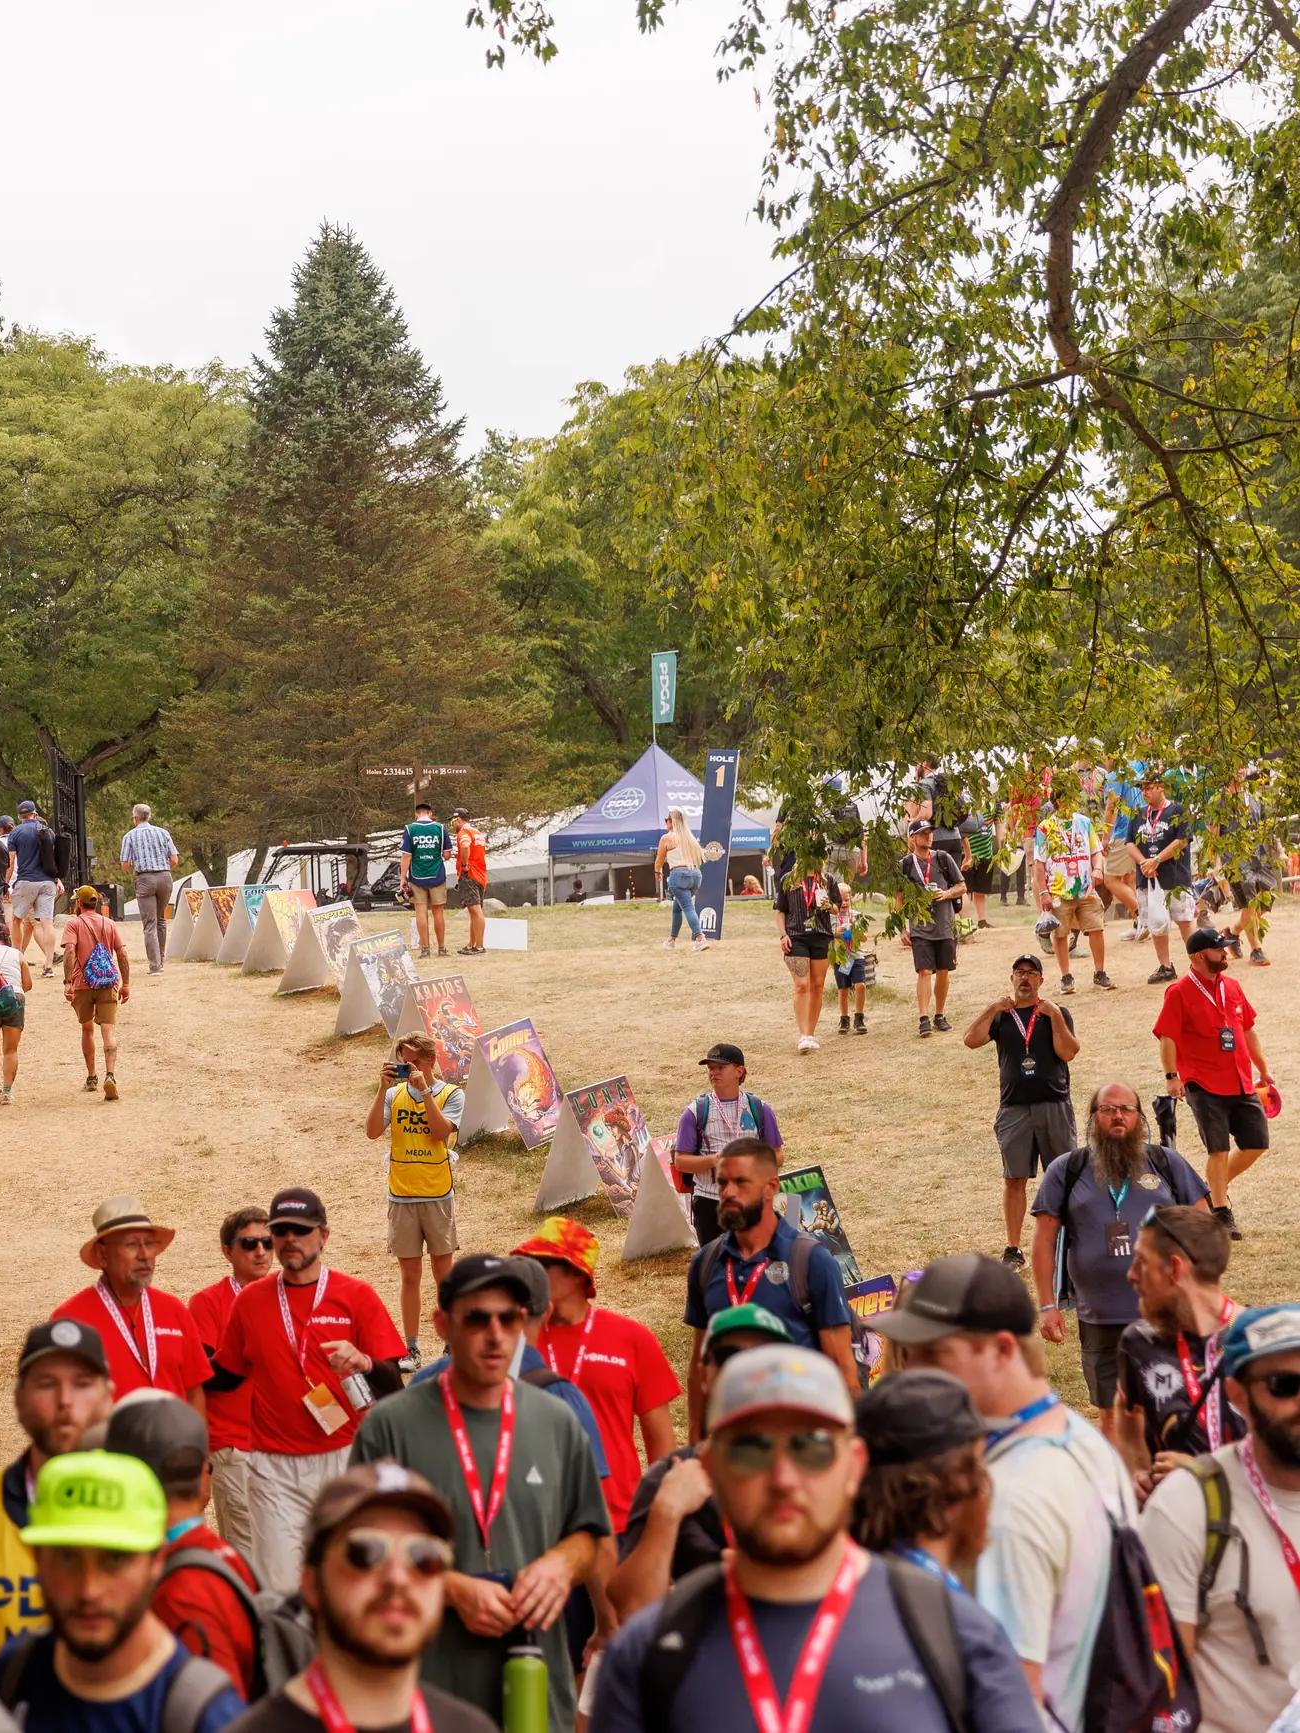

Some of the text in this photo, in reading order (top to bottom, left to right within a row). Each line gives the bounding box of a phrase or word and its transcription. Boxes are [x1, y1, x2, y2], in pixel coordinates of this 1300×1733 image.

[659, 662, 670, 716] PDGA
[709, 755, 734, 763] HOLE
[715, 765, 726, 787] 1
[607, 798, 640, 809] PDGA
[413, 835, 440, 845] PDGA
[572, 838, 636, 848] WWW.PDGA.COM
[245, 888, 280, 896] FOR
[314, 907, 351, 922] RAPTOR
[356, 934, 400, 955] NUKE
[413, 979, 464, 1001] KRATOS
[573, 1082, 628, 1115] LUNA
[397, 1109, 429, 1125] PDG
[403, 1126, 432, 1135] MAJO
[780, 1171, 824, 1194] TAKER
[848, 1290, 893, 1317] met
[155, 1327, 183, 1336] ORLDS
